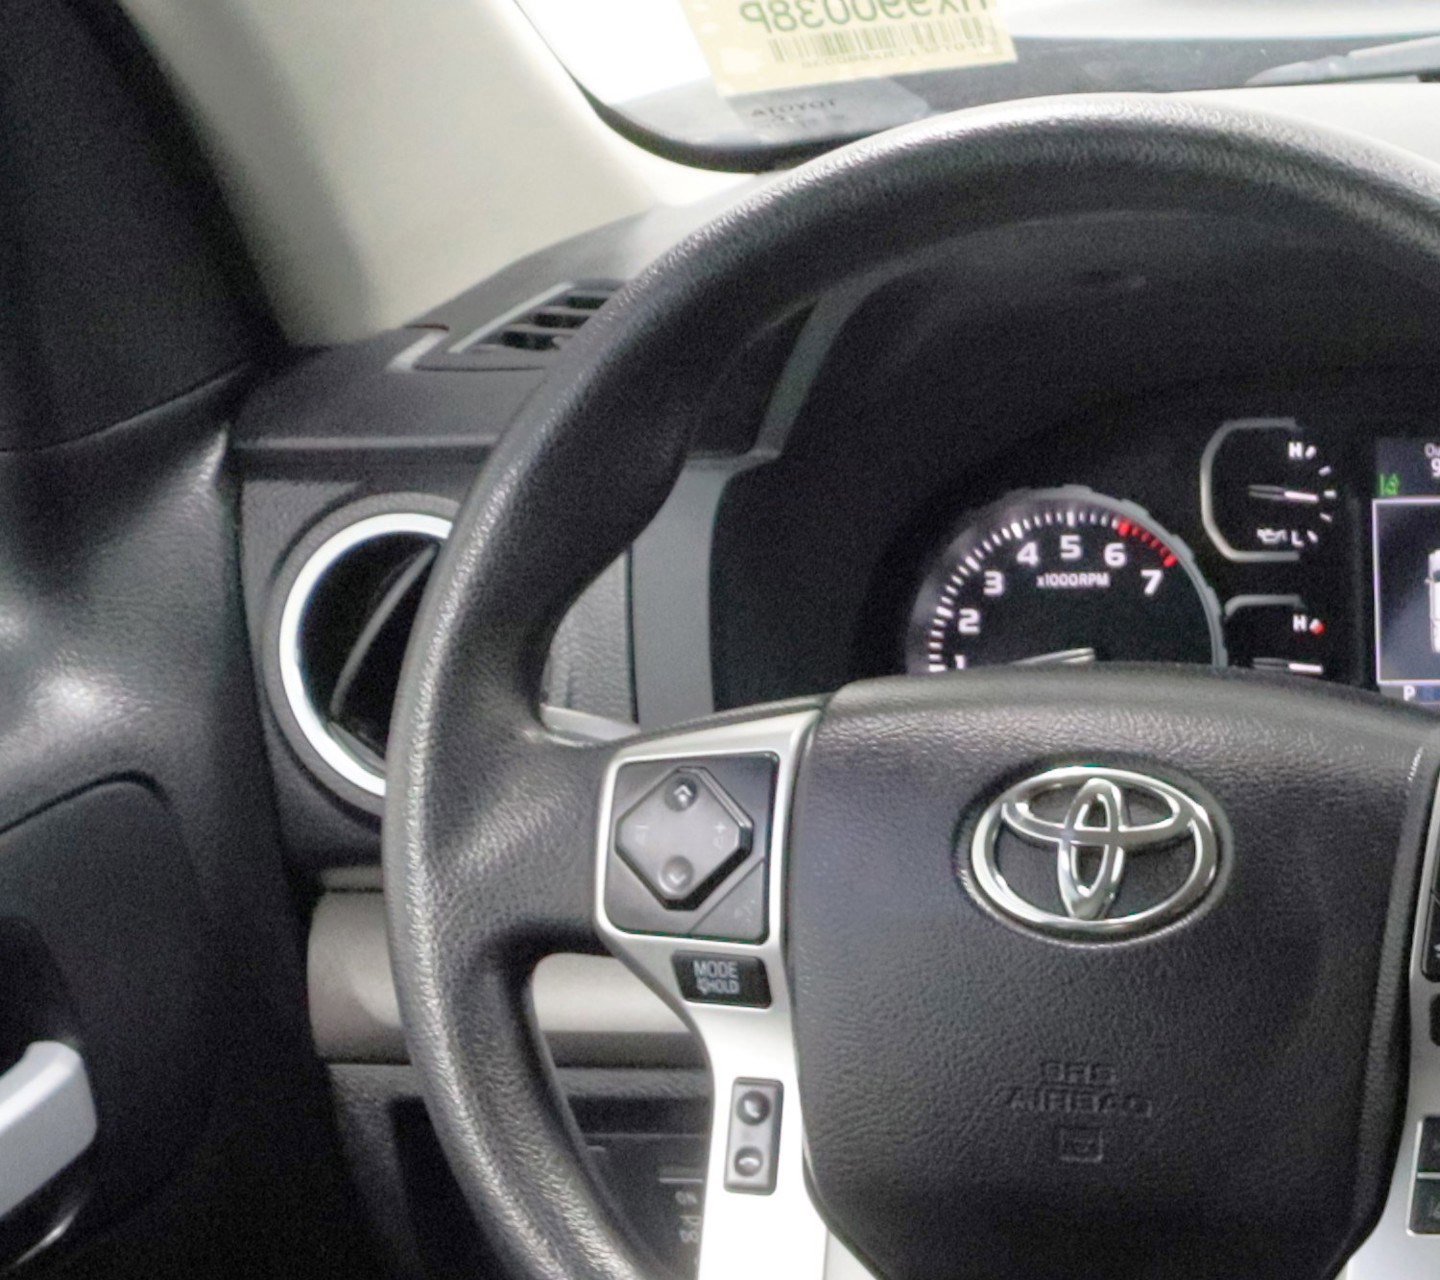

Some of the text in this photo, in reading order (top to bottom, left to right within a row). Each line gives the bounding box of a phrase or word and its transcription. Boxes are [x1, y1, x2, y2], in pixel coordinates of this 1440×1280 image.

[1288, 442, 1303, 459] H
[1060, 535, 1082, 560] 5
[1291, 530, 1304, 547] L
[1016, 541, 1039, 566] 4
[1104, 543, 1127, 567] 6
[983, 571, 1005, 596] 3
[1141, 570, 1163, 596] 7
[958, 608, 980, 634] 2
[1293, 615, 1307, 631] H
[1404, 685, 1416, 700] P
[693, 960, 739, 979] MODE
